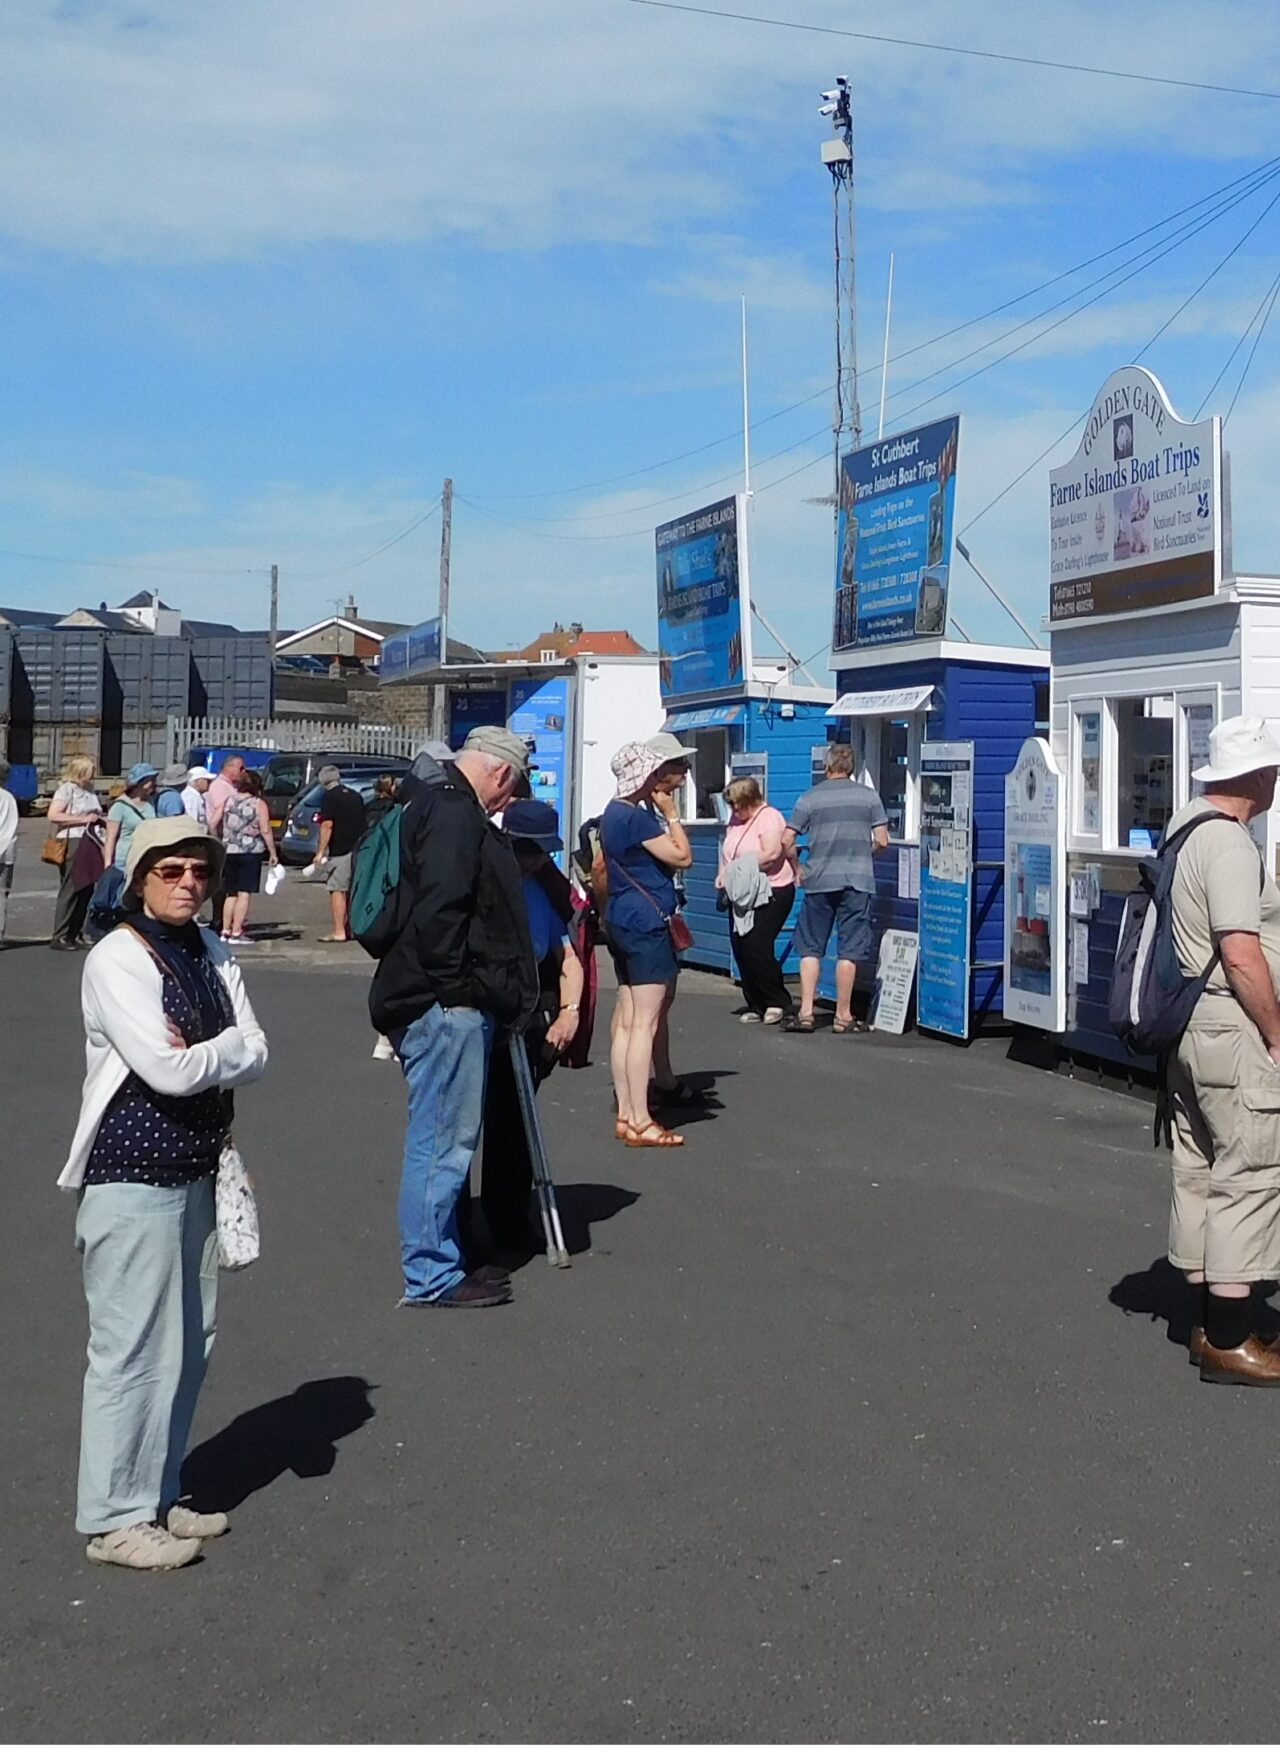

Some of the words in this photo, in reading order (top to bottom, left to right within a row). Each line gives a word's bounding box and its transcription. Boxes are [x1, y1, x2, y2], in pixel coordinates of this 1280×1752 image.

[1083, 386, 1131, 457] GOLDEN
[1132, 386, 1167, 437] GATE
[854, 481, 873, 499] Farne
[874, 472, 896, 494] Islands
[898, 466, 917, 487] Boat
[918, 459, 937, 482] Trips
[871, 447, 881, 468] St
[882, 437, 920, 463] Cuthbert
[1050, 479, 1082, 508] Farne
[1084, 461, 1127, 499] Islands
[1131, 454, 1161, 486] Boat
[1164, 441, 1200, 477] Trips
